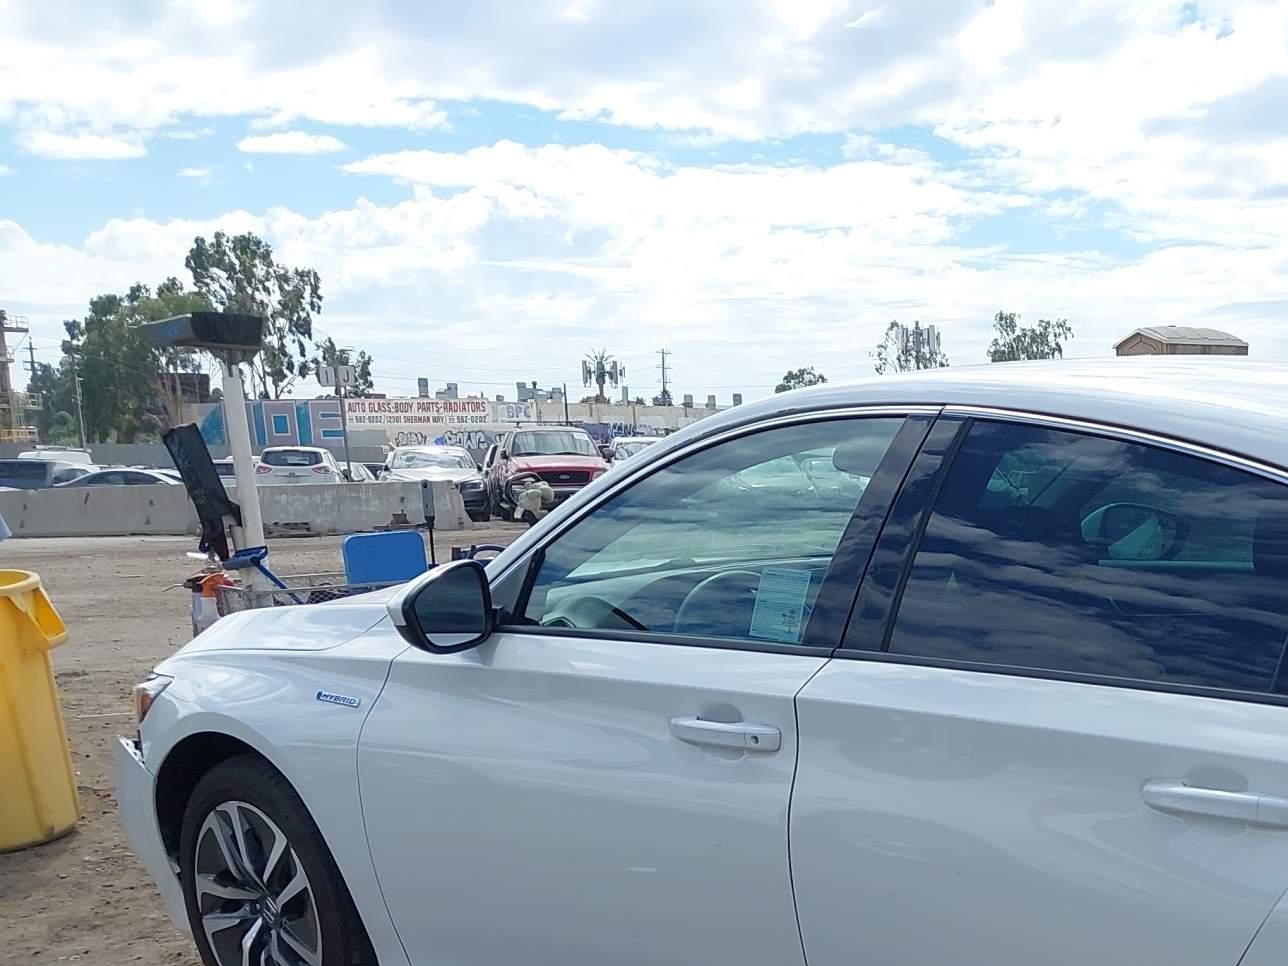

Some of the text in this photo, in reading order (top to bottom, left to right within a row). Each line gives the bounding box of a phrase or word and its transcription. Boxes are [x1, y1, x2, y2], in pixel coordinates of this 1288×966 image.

[342, 369, 350, 383] J
[348, 402, 366, 413] AUTO
[403, 415, 430, 424] SHERMAN
[321, 693, 356, 705] HYBRID
